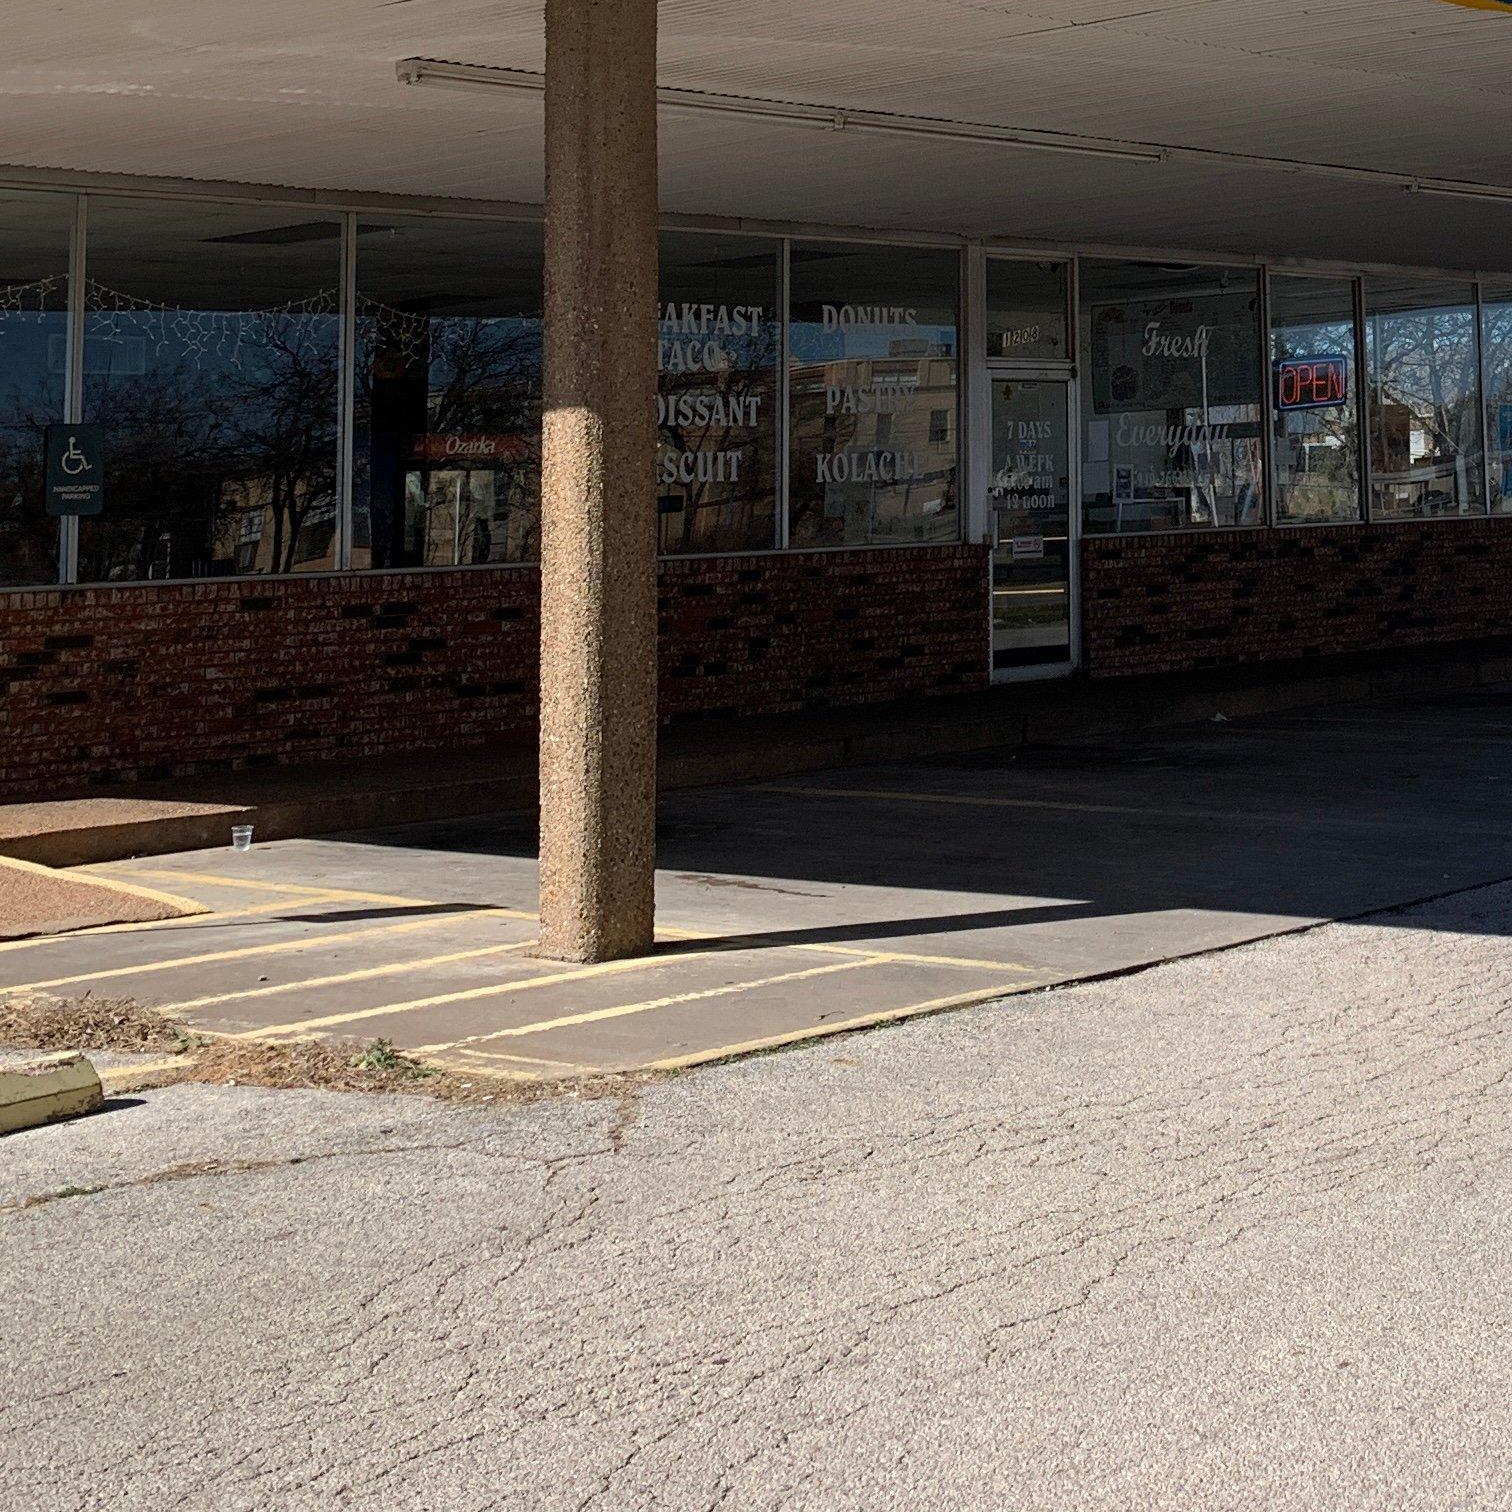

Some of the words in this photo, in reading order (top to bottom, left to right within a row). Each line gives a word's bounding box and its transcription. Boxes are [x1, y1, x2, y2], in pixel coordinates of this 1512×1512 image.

[657, 301, 763, 337] AKFAST
[822, 304, 918, 336] DONUTS
[1142, 321, 1211, 358] Fresh
[1280, 362, 1344, 405] OPEN
[1007, 421, 1014, 439] 7
[1018, 421, 1052, 439] DAYS
[657, 450, 742, 484] SCUIT
[1017, 454, 1055, 473] WEEK
